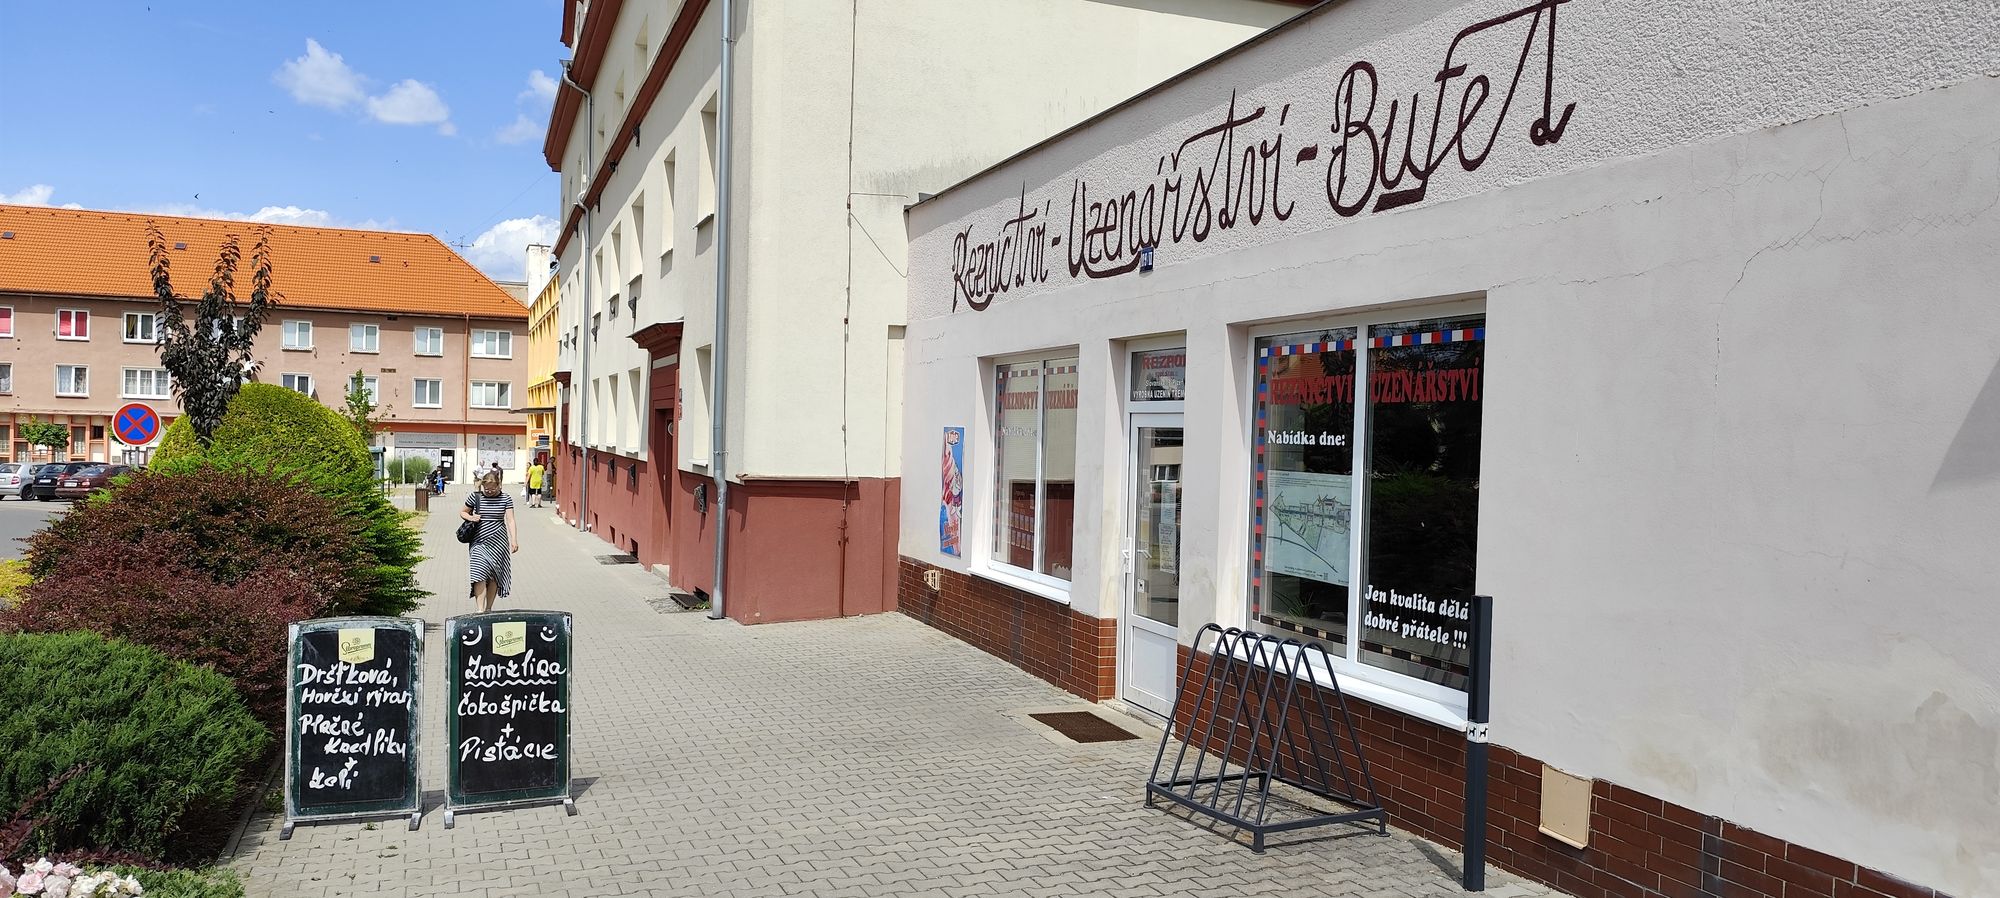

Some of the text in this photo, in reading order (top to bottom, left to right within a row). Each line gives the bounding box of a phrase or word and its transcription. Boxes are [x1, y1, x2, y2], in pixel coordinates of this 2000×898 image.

[1068, 88, 1295, 278] Uzenářství
[1326, 0, 1577, 217] Bufet
[1370, 357, 1480, 404] UZENÁŘSTVÍ
[1267, 430, 1346, 446] Nabídka dne:
[1364, 584, 1469, 621] Jen kvalita dělá
[1364, 610, 1468, 650] dobré přátele !!!
[464, 648, 567, 680] Zmrzlina
[457, 690, 566, 719] Čokošpička
[459, 734, 559, 762] Pistácie
